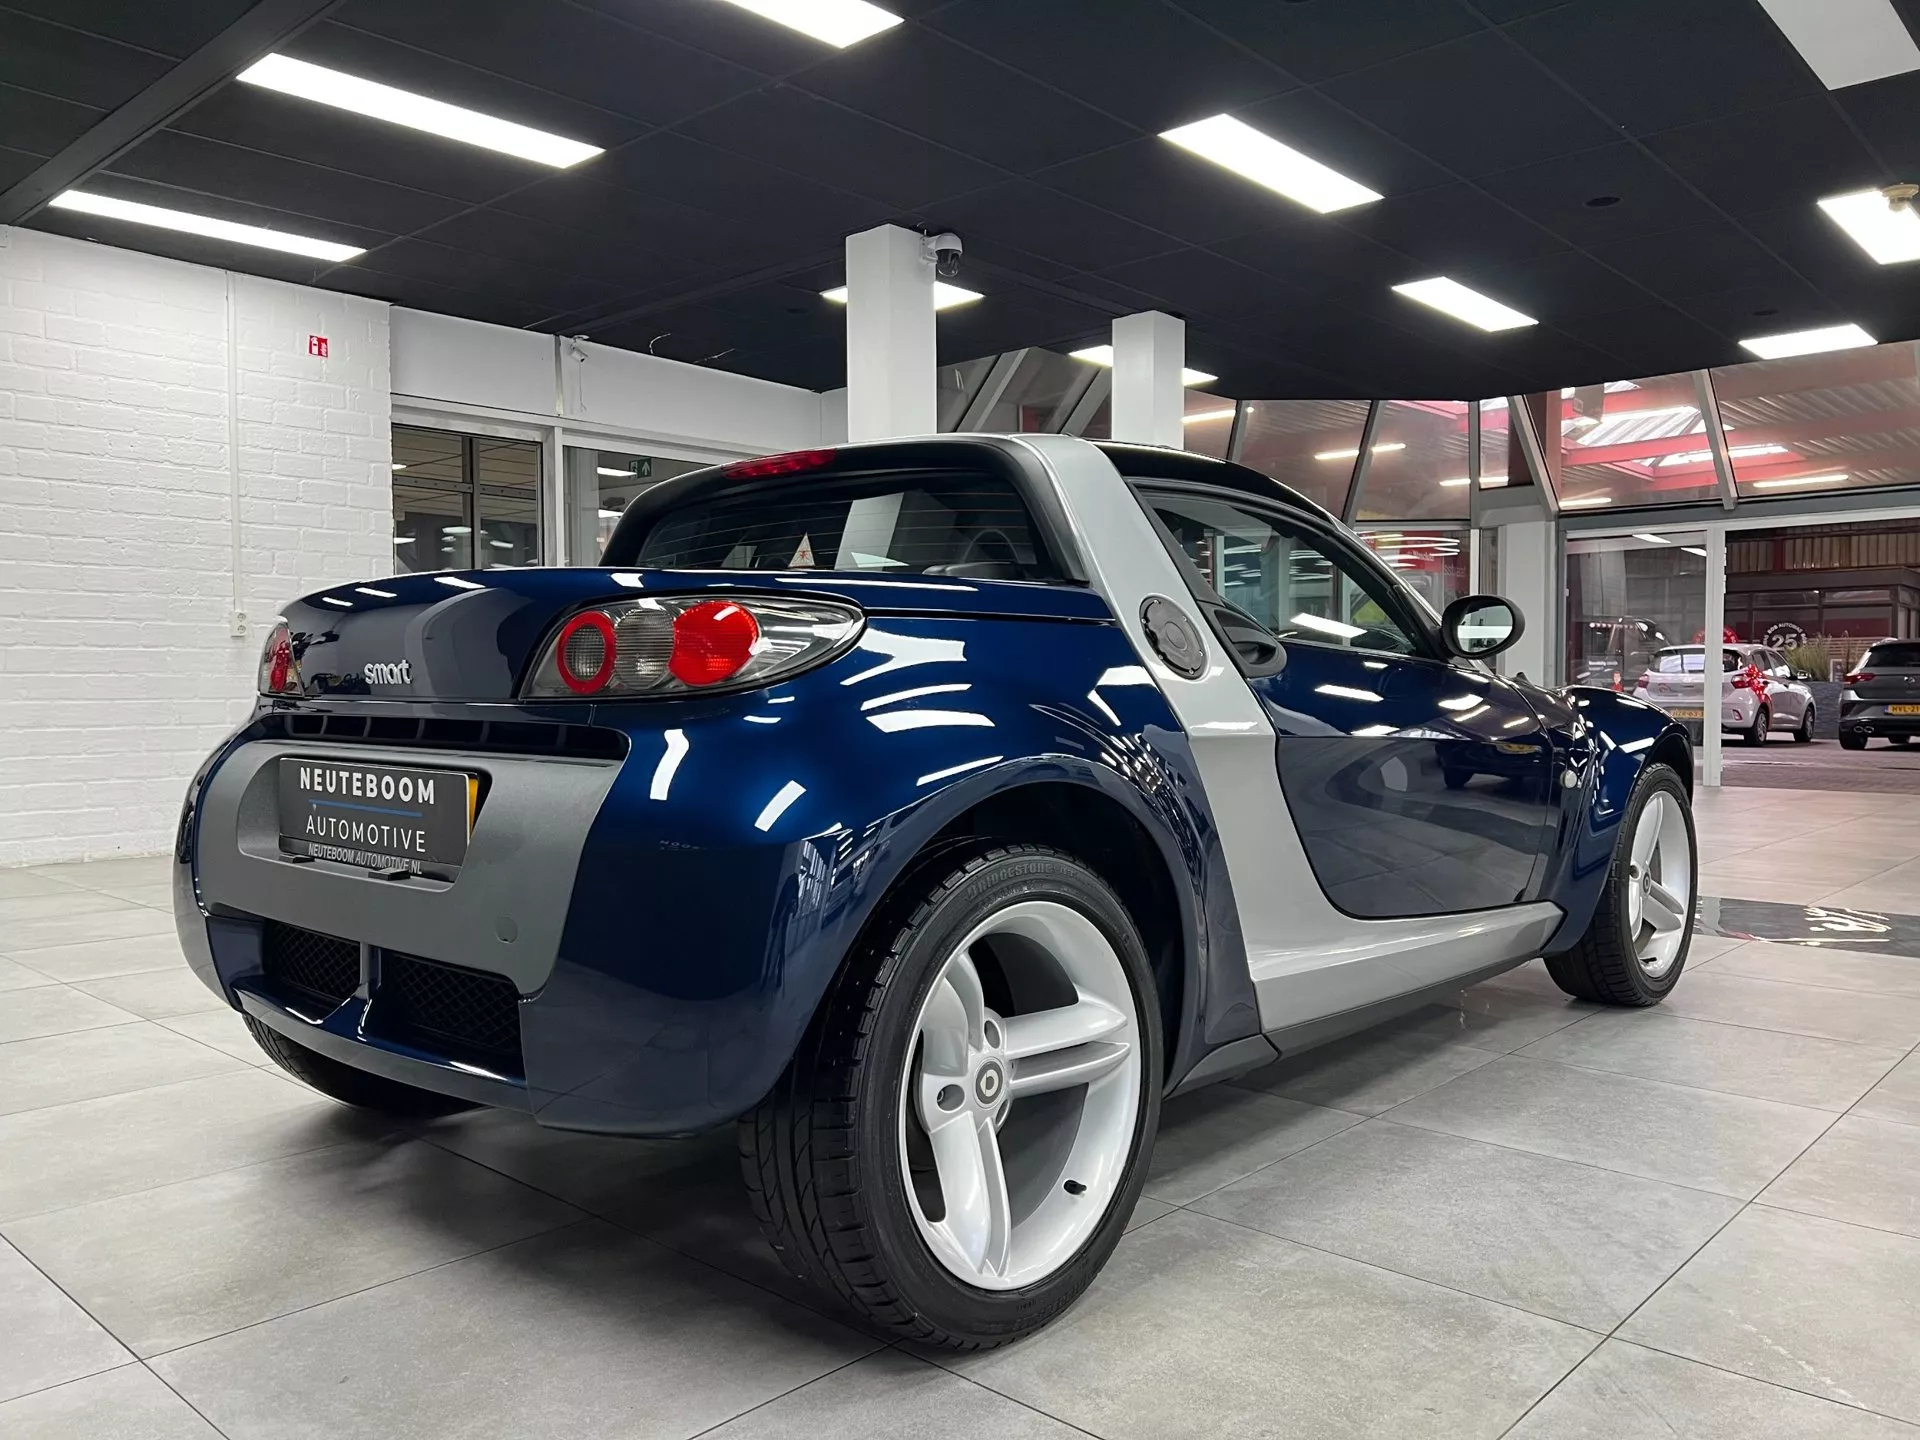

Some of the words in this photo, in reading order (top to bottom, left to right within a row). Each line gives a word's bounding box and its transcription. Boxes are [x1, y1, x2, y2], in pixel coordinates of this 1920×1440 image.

[1772, 634, 1797, 650] 25
[364, 659, 411, 685] smart
[300, 766, 435, 805] NEUTEBOOM
[306, 814, 426, 853] AUTOMOTIVE
[308, 843, 354, 864] NEUTEBOOM
[355, 850, 422, 875] AUTOMOTIVE.NL
